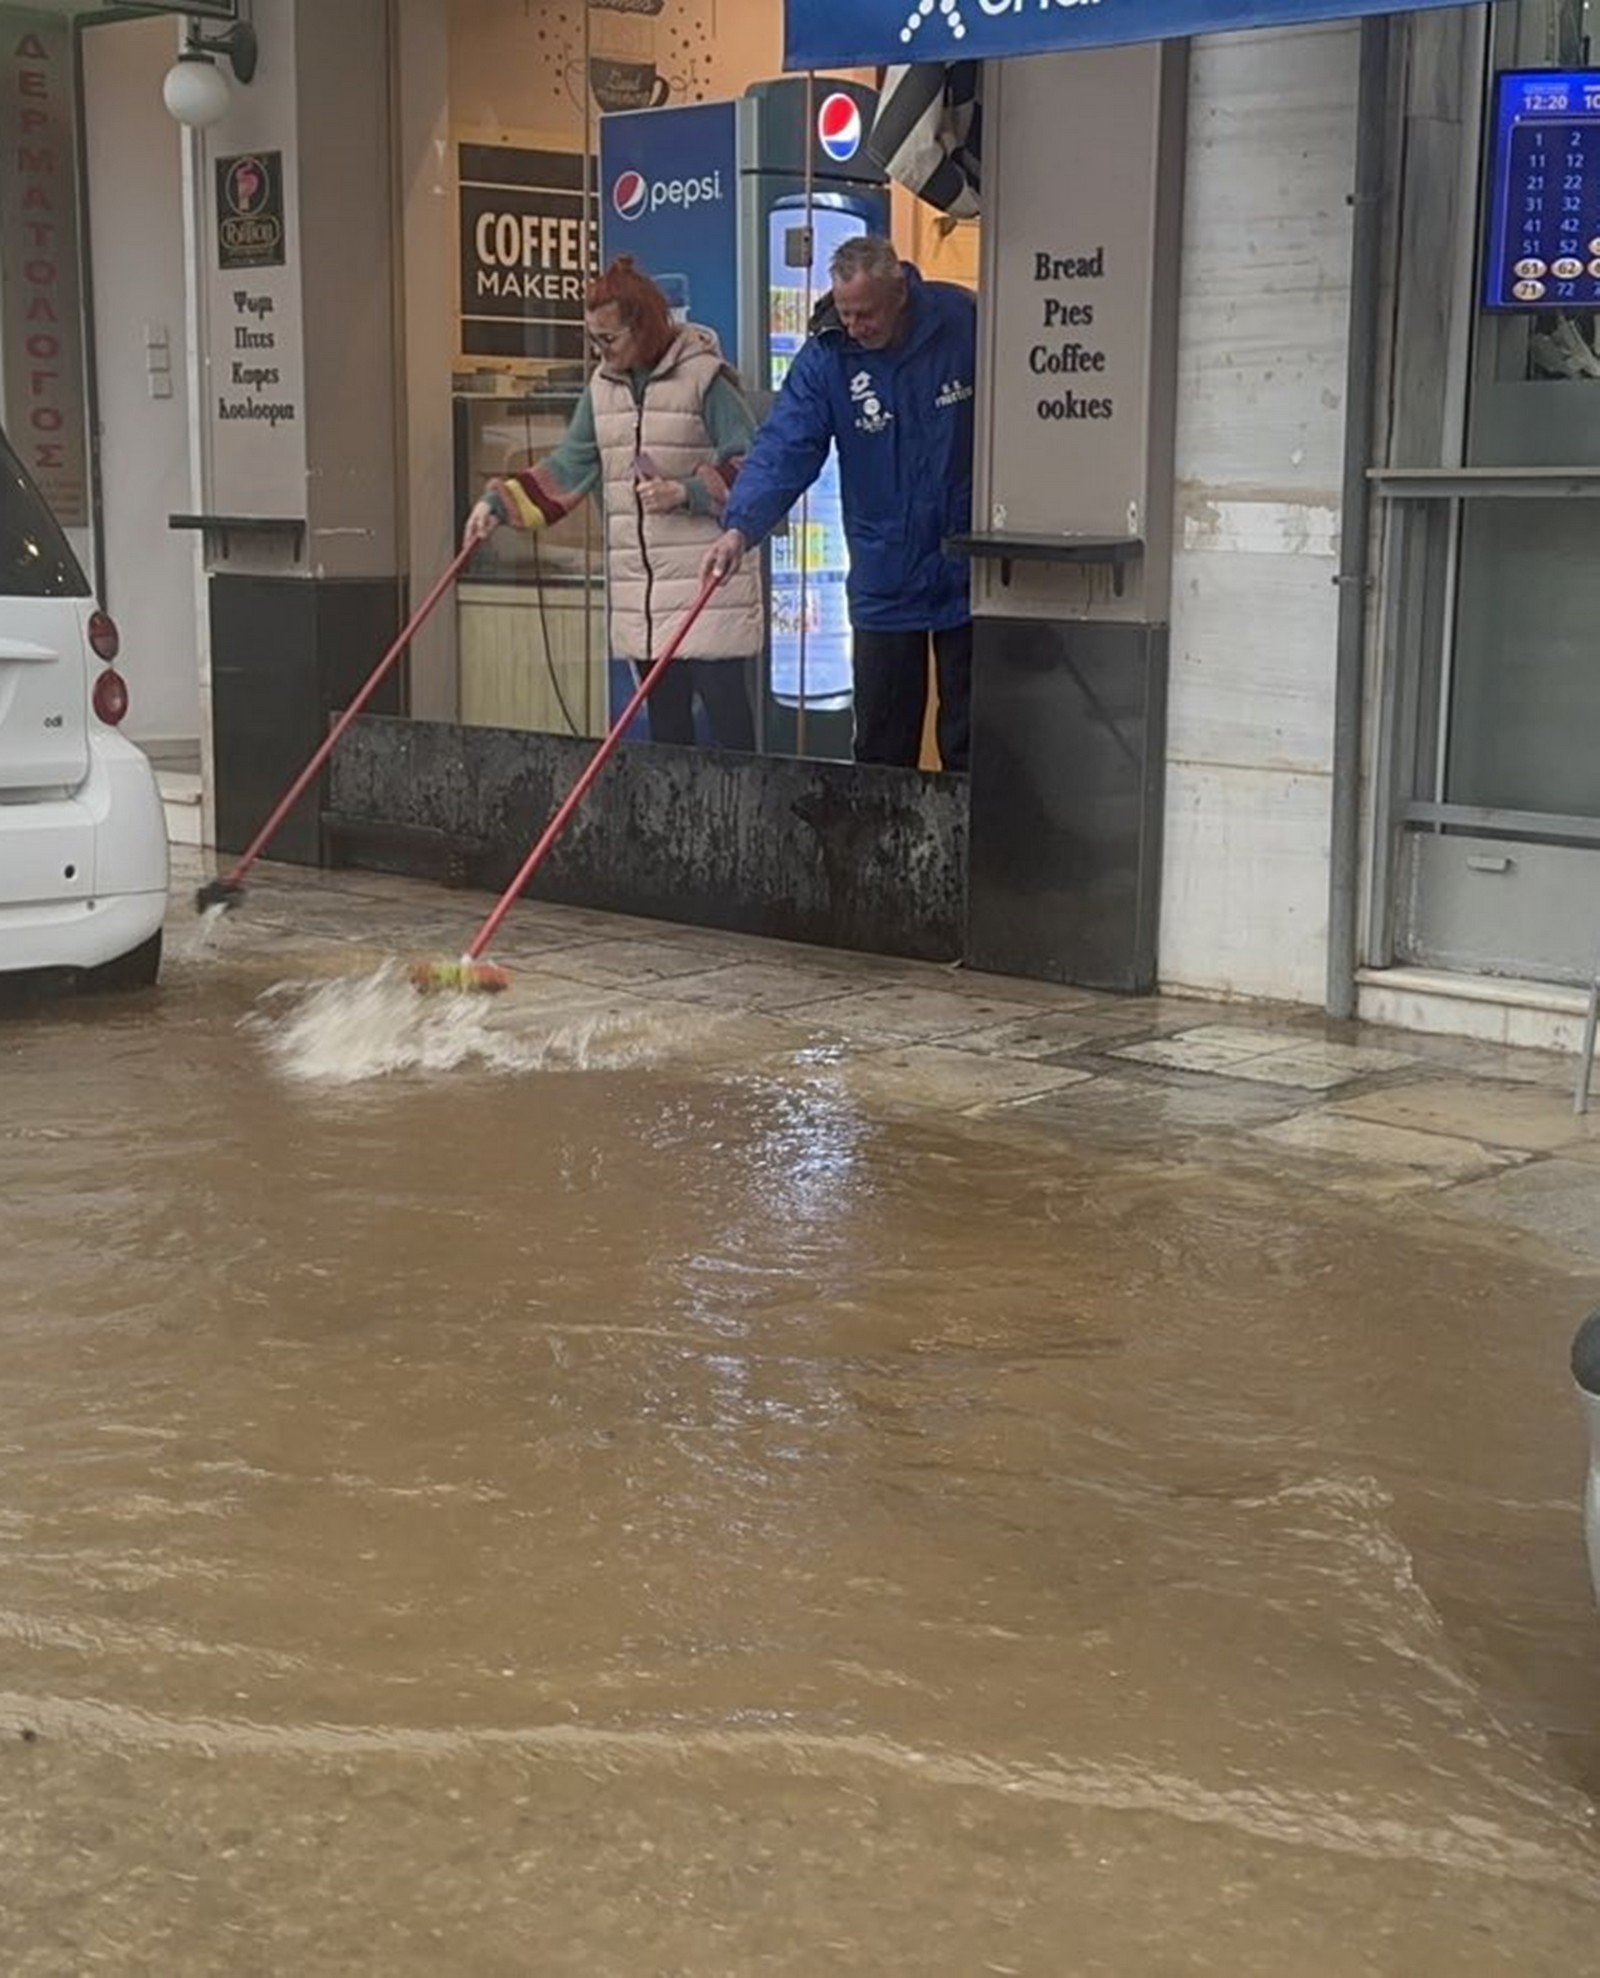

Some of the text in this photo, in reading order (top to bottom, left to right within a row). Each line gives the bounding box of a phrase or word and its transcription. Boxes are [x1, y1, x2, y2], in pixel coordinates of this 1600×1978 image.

[1524, 95, 1568, 110] 12:20
[1535, 131, 1581, 147] 1 2
[1530, 153, 1584, 168] 11 12
[1527, 175, 1582, 190] 21 22
[651, 169, 720, 212] pepsi
[1525, 197, 1542, 212] 31
[1523, 218, 1580, 232] 41 42
[475, 212, 598, 271] COFFEE
[1523, 240, 1578, 254] 51 52
[1034, 247, 1104, 281] Bread
[1521, 262, 1577, 275] 61 62
[1519, 282, 1575, 296] 71 72
[1043, 299, 1093, 327] Pies
[1029, 343, 1105, 374] Coffee
[1037, 389, 1113, 419] ookies
